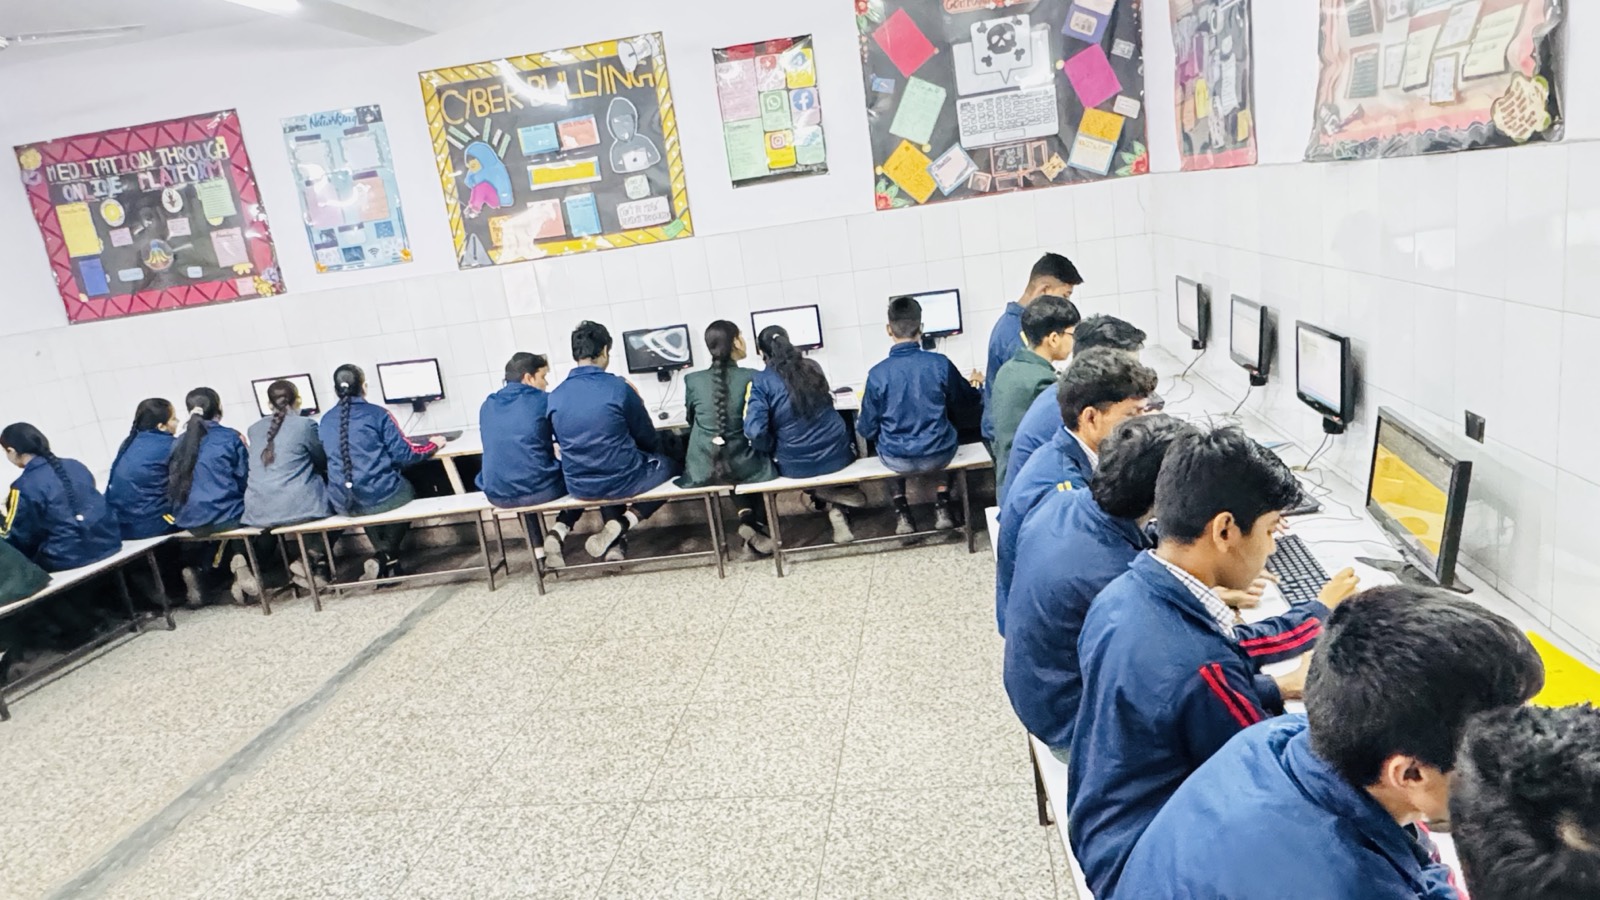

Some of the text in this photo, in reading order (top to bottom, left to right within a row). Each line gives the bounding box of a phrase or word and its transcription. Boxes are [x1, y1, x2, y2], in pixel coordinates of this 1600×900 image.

[440, 83, 525, 125] CYBER
[46, 136, 230, 182] MEDITATION THROUGH
[62, 160, 226, 203] ONLINE PLATFORM
